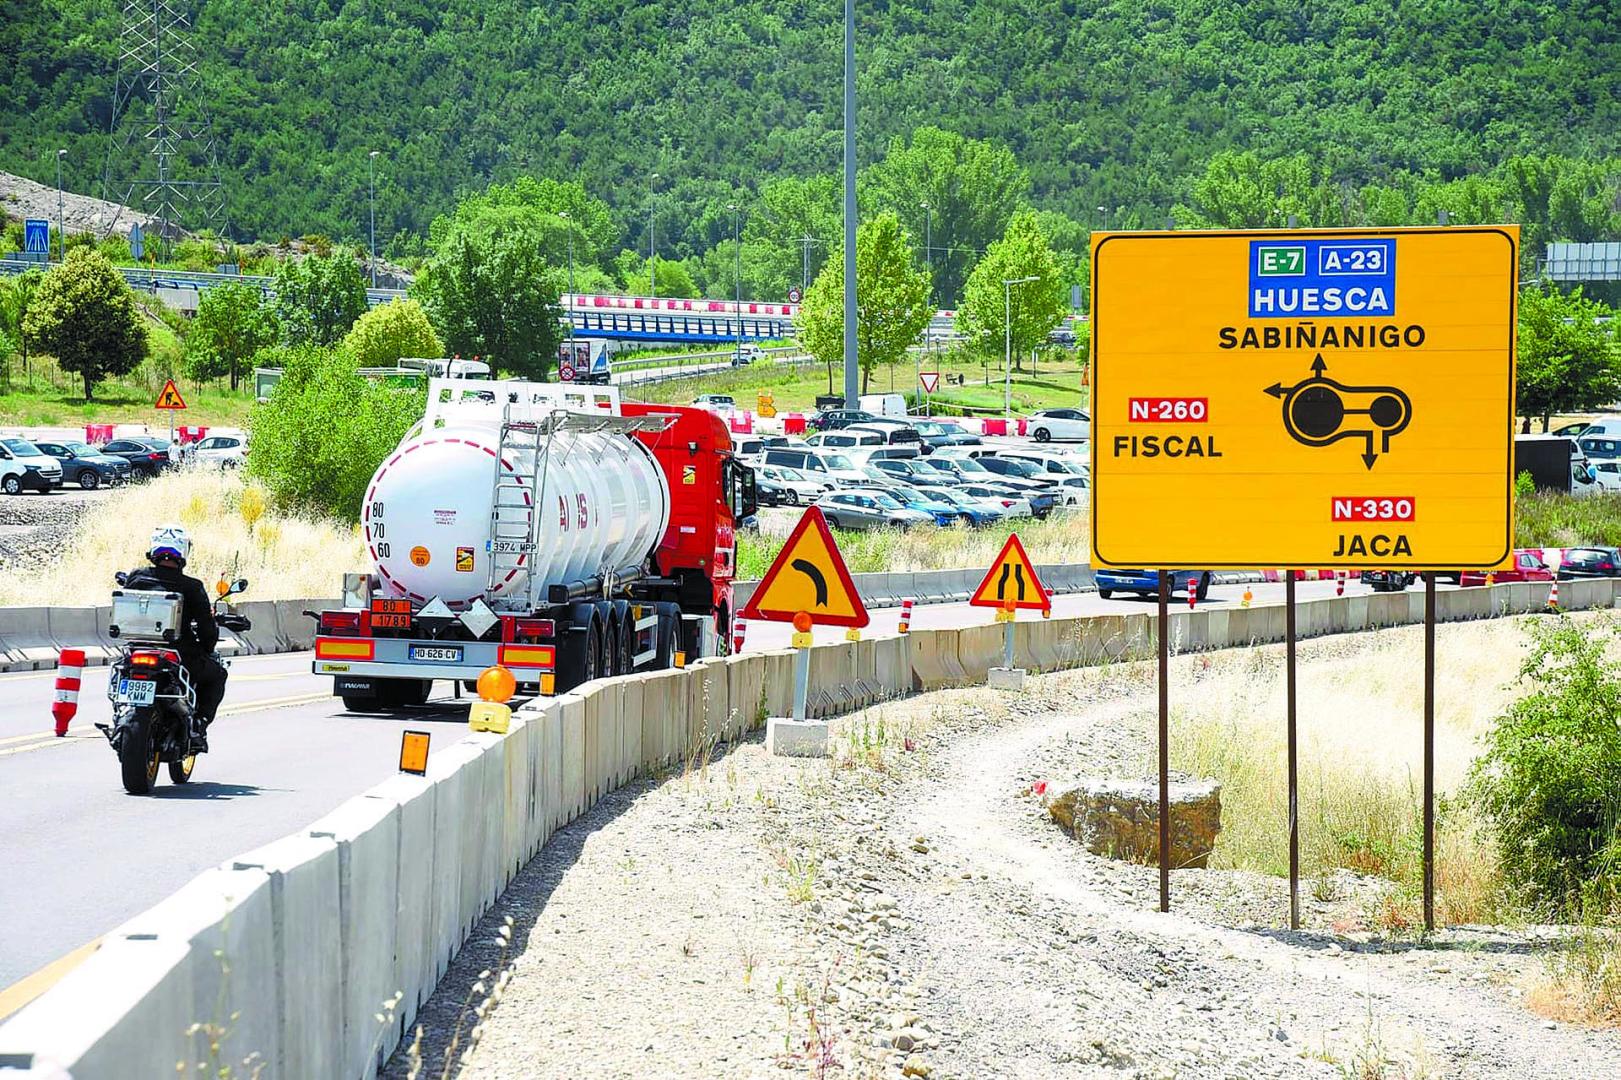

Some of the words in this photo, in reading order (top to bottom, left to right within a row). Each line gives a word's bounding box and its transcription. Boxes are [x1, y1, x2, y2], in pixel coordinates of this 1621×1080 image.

[1263, 252, 1301, 271] E-7
[1325, 250, 1382, 270] A-23
[1253, 287, 1389, 312] HUESCA
[1219, 322, 1426, 348] SABIÑANIGO
[1132, 401, 1205, 419] N-260
[1114, 436, 1223, 458] FISCAL
[372, 501, 384, 518] 80
[1335, 499, 1412, 518] N-330
[373, 522, 385, 539] 70
[377, 542, 391, 559] 60
[493, 542, 516, 552] 3974
[1333, 534, 1412, 557] JACA
[383, 600, 396, 612] 80
[379, 615, 407, 627] 1789
